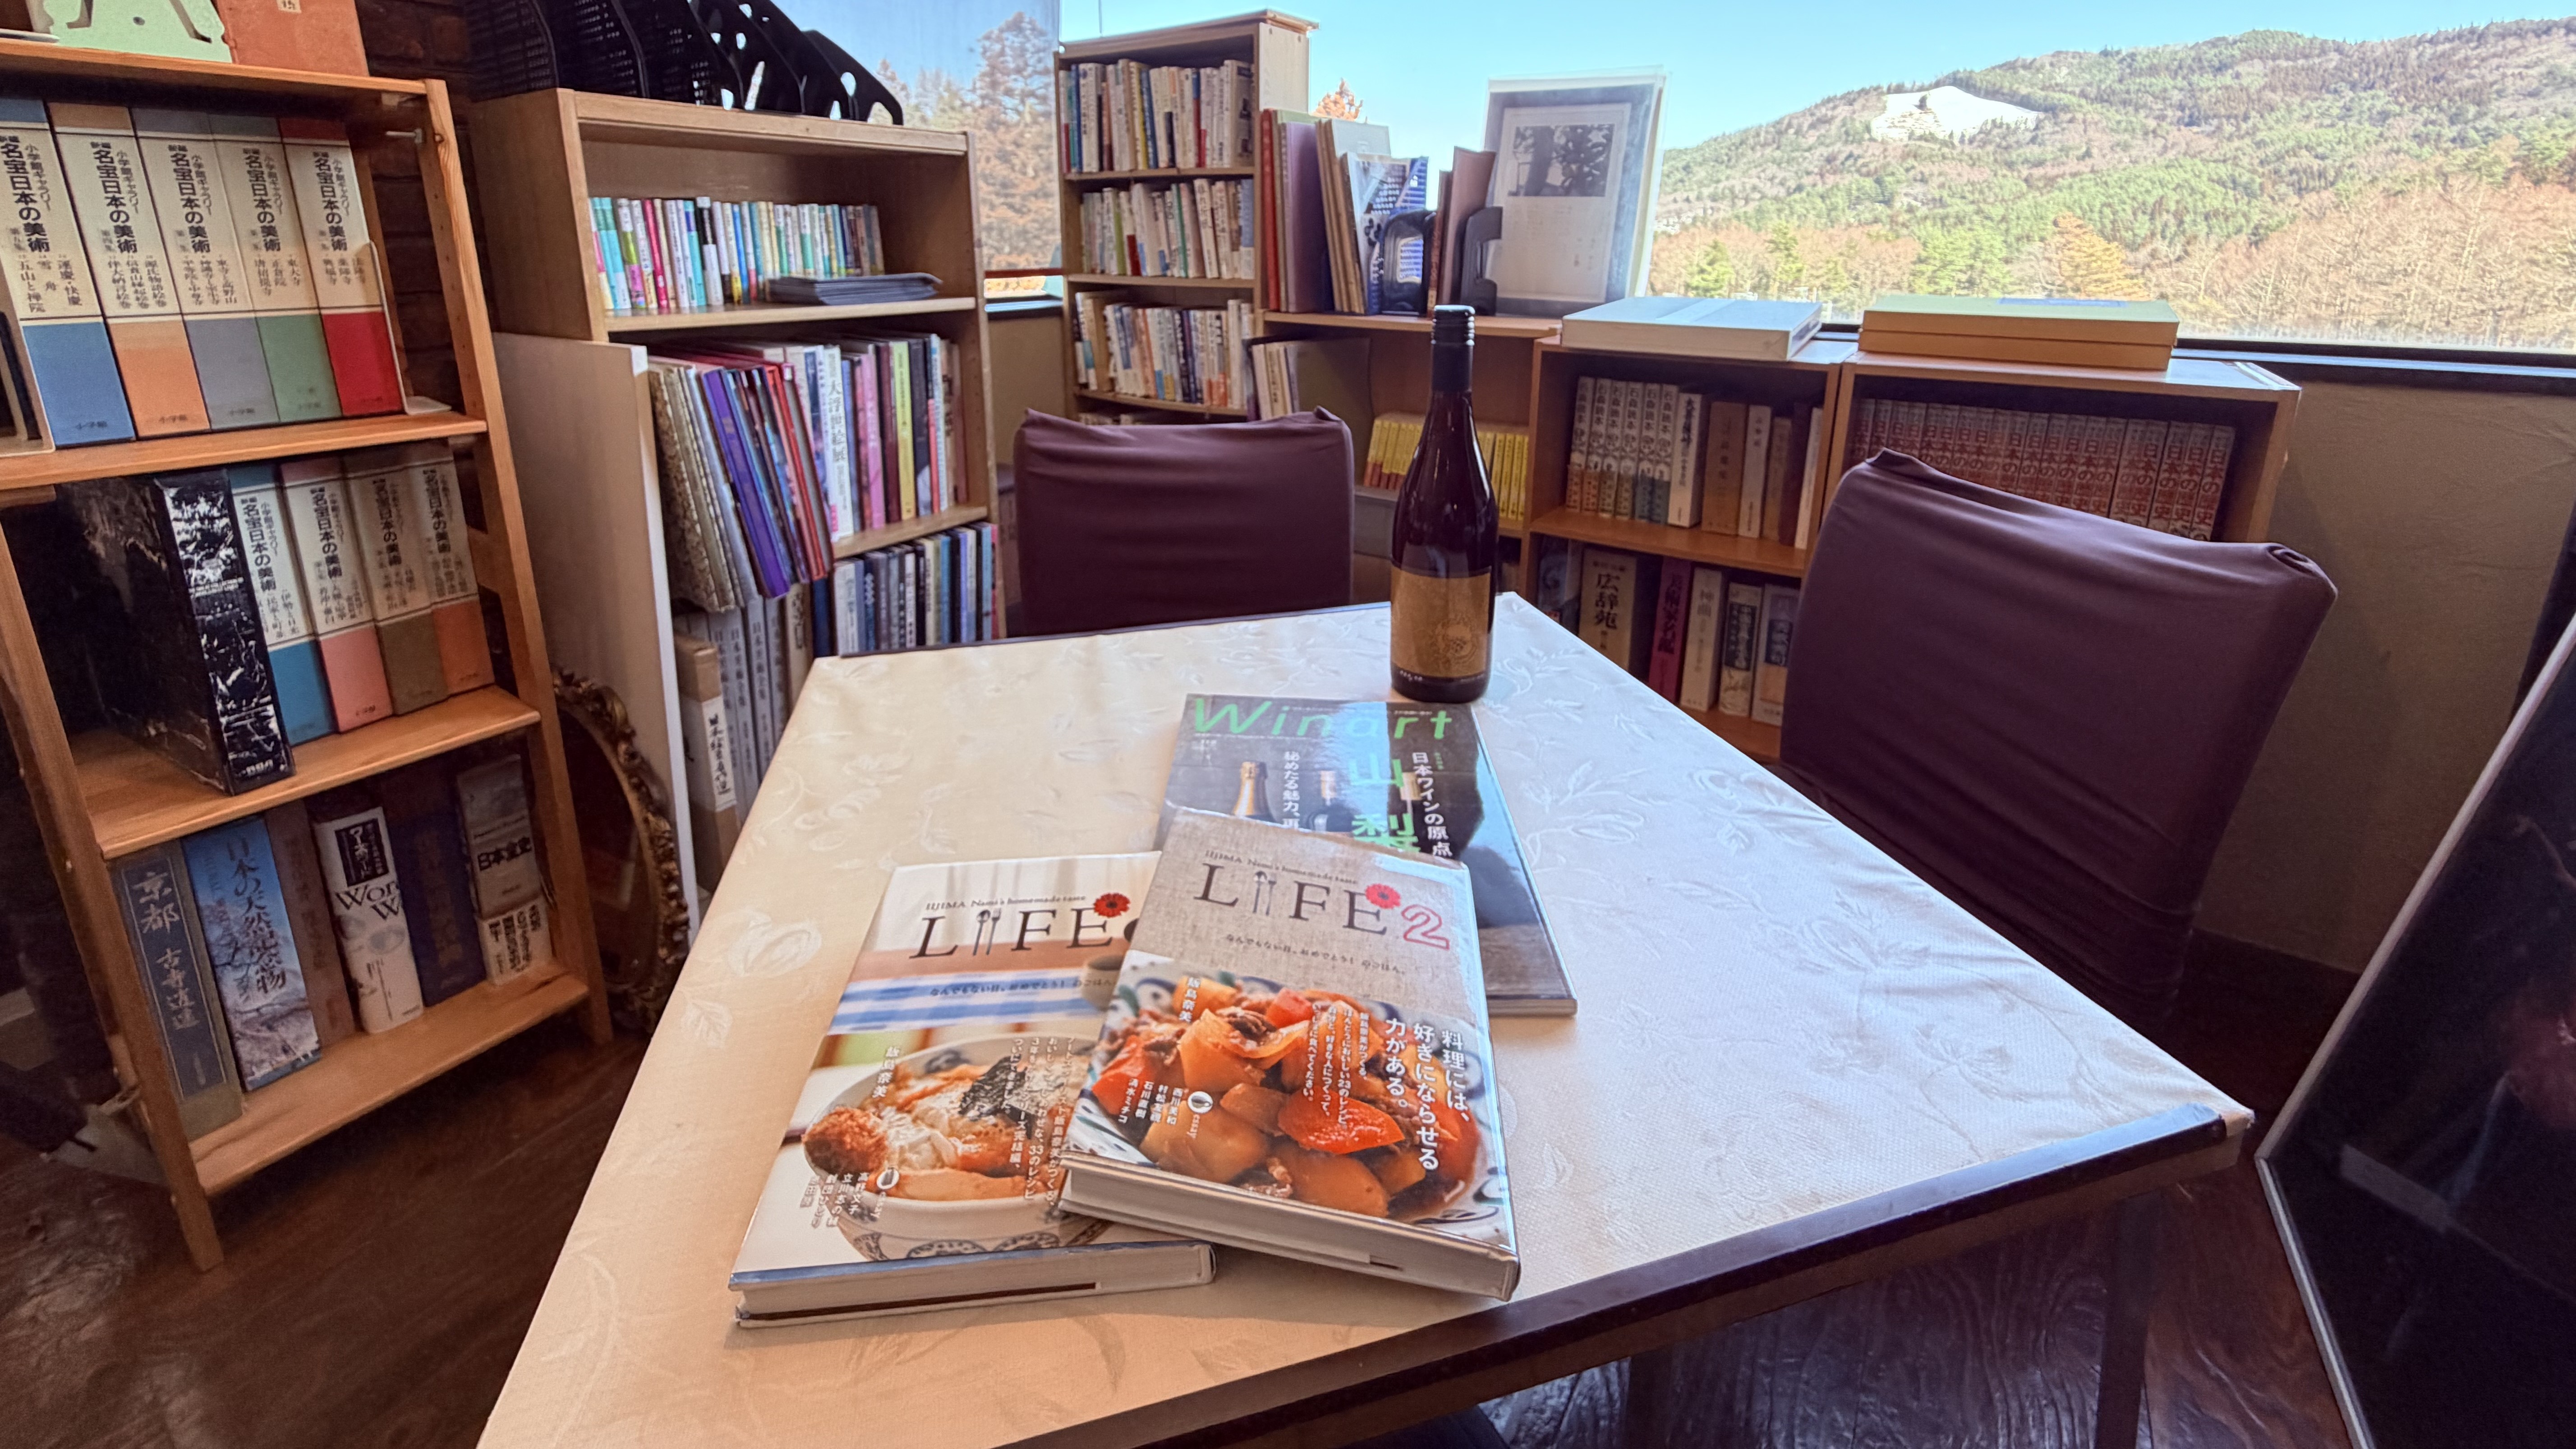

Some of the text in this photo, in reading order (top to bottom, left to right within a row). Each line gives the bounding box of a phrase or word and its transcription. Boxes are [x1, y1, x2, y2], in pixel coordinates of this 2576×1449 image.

[93, 149, 138, 253] 名宝日本の美術
[170, 151, 211, 253] 名宝日本の美術
[244, 154, 281, 252] 名宝日本の美術
[314, 156, 348, 252] 名宝日本の美術
[1594, 573, 1621, 630] 広辞苑
[1194, 697, 1453, 740] Winart
[1412, 751, 1453, 857] 日本ワインの原点
[132, 871, 181, 934] 京都
[1385, 1017, 1408, 1108] 力がある。
[1413, 1022, 1439, 1171] 好きにならせる
[1442, 1030, 1470, 1122] 料理には、
